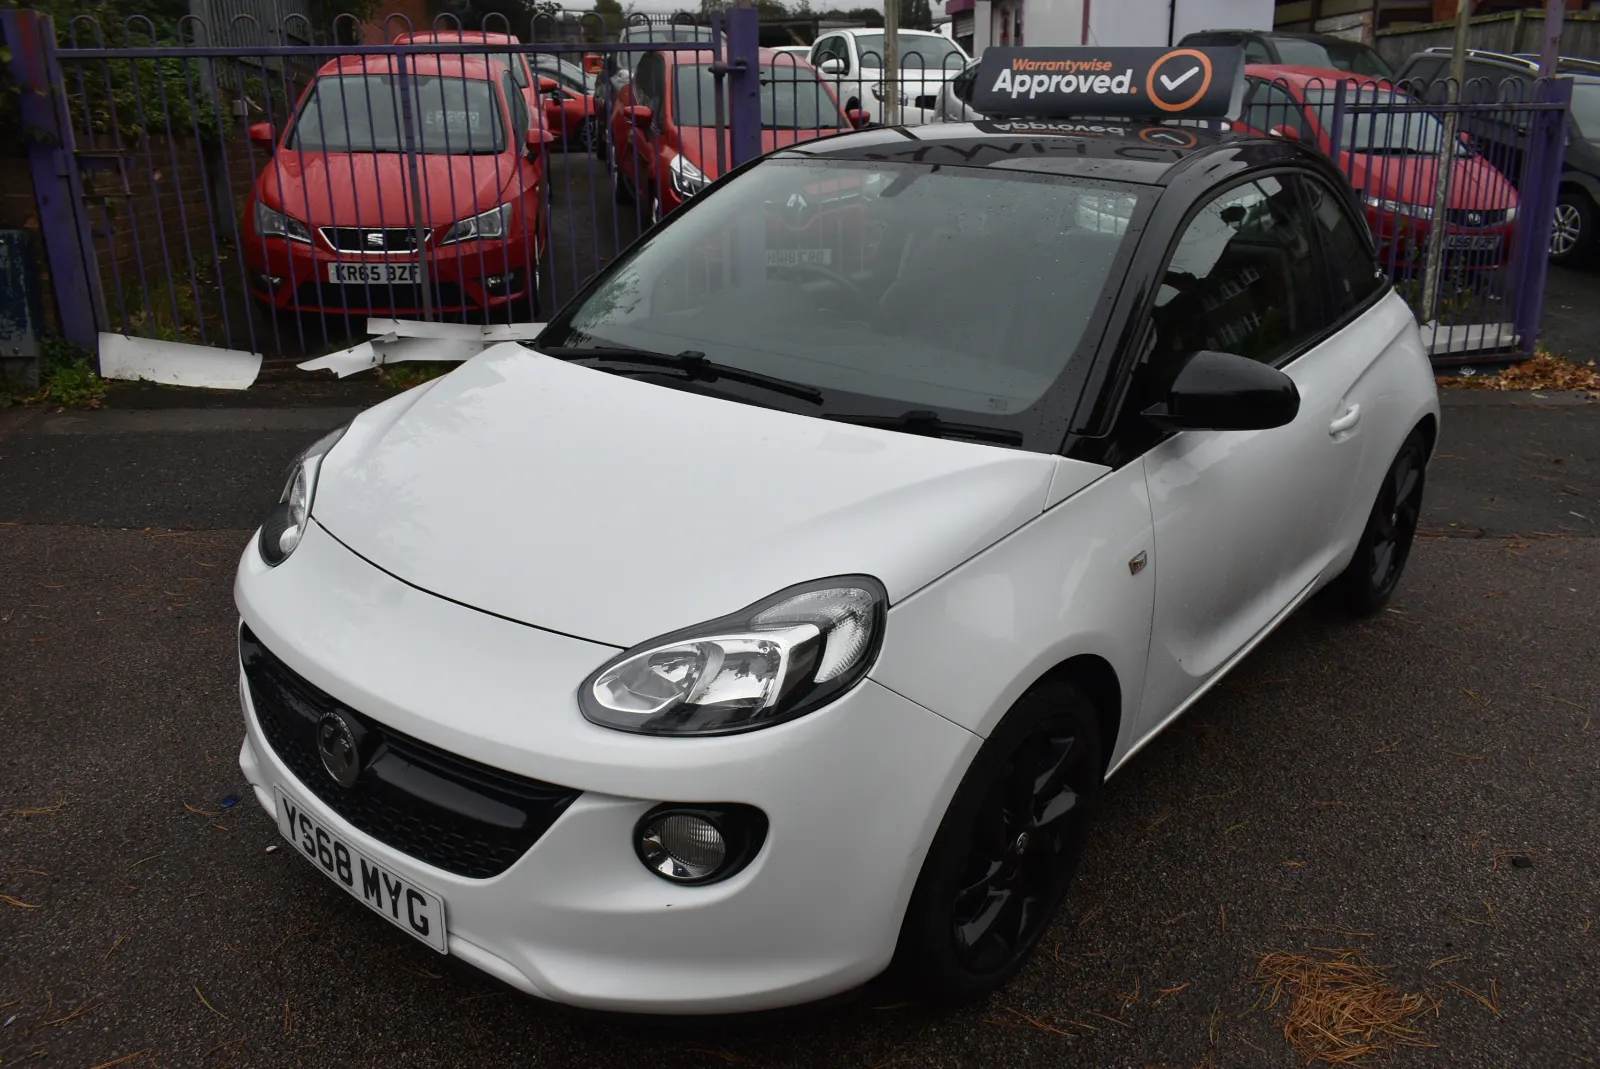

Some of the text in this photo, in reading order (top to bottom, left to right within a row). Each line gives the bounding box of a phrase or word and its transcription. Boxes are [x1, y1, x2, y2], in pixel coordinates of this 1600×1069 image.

[1012, 58, 1112, 73] Warrantywise
[992, 68, 1138, 99] Approved.
[335, 265, 381, 281] KR65
[283, 797, 429, 936] YS68 MYG
